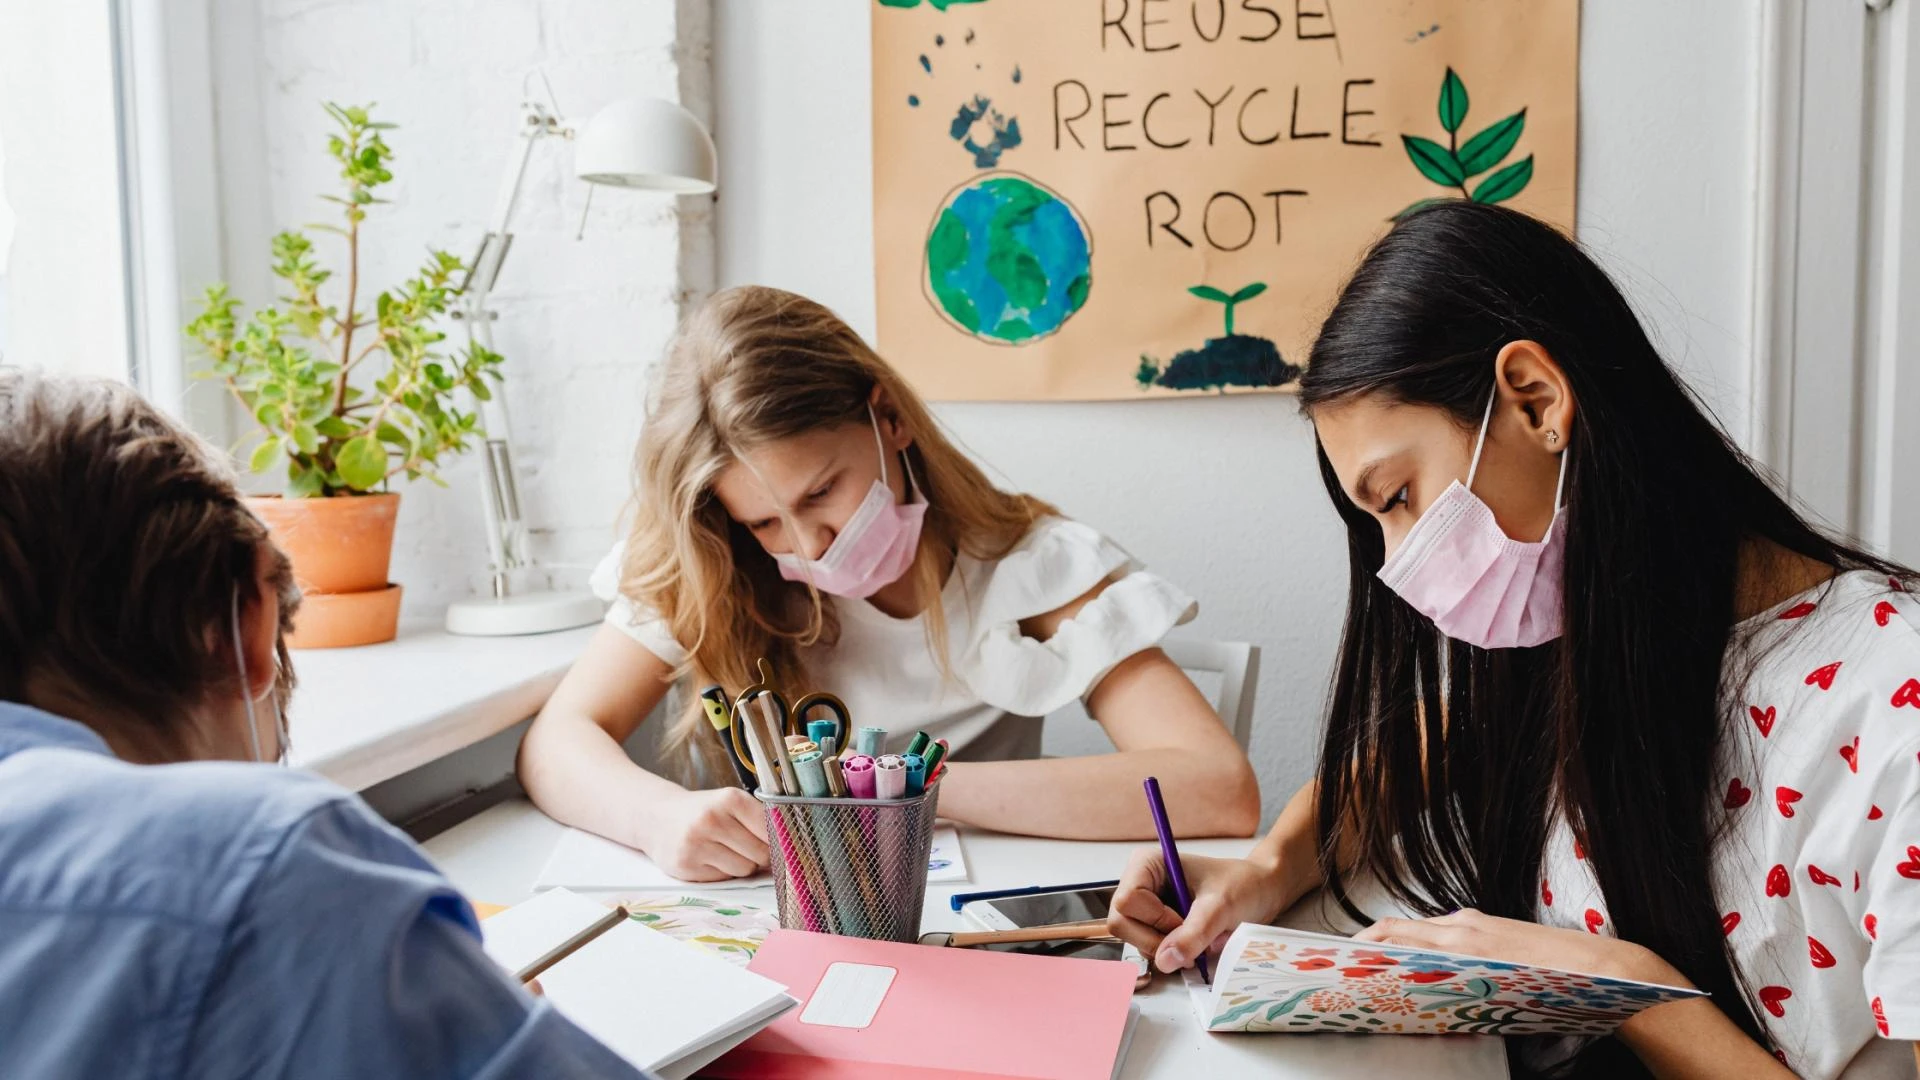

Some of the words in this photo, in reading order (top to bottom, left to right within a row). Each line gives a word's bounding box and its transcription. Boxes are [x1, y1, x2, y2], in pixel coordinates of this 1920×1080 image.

[1102, 0, 1337, 52] REUSE
[1053, 78, 1383, 151] RECYCLE
[1144, 189, 1309, 252] ROT
